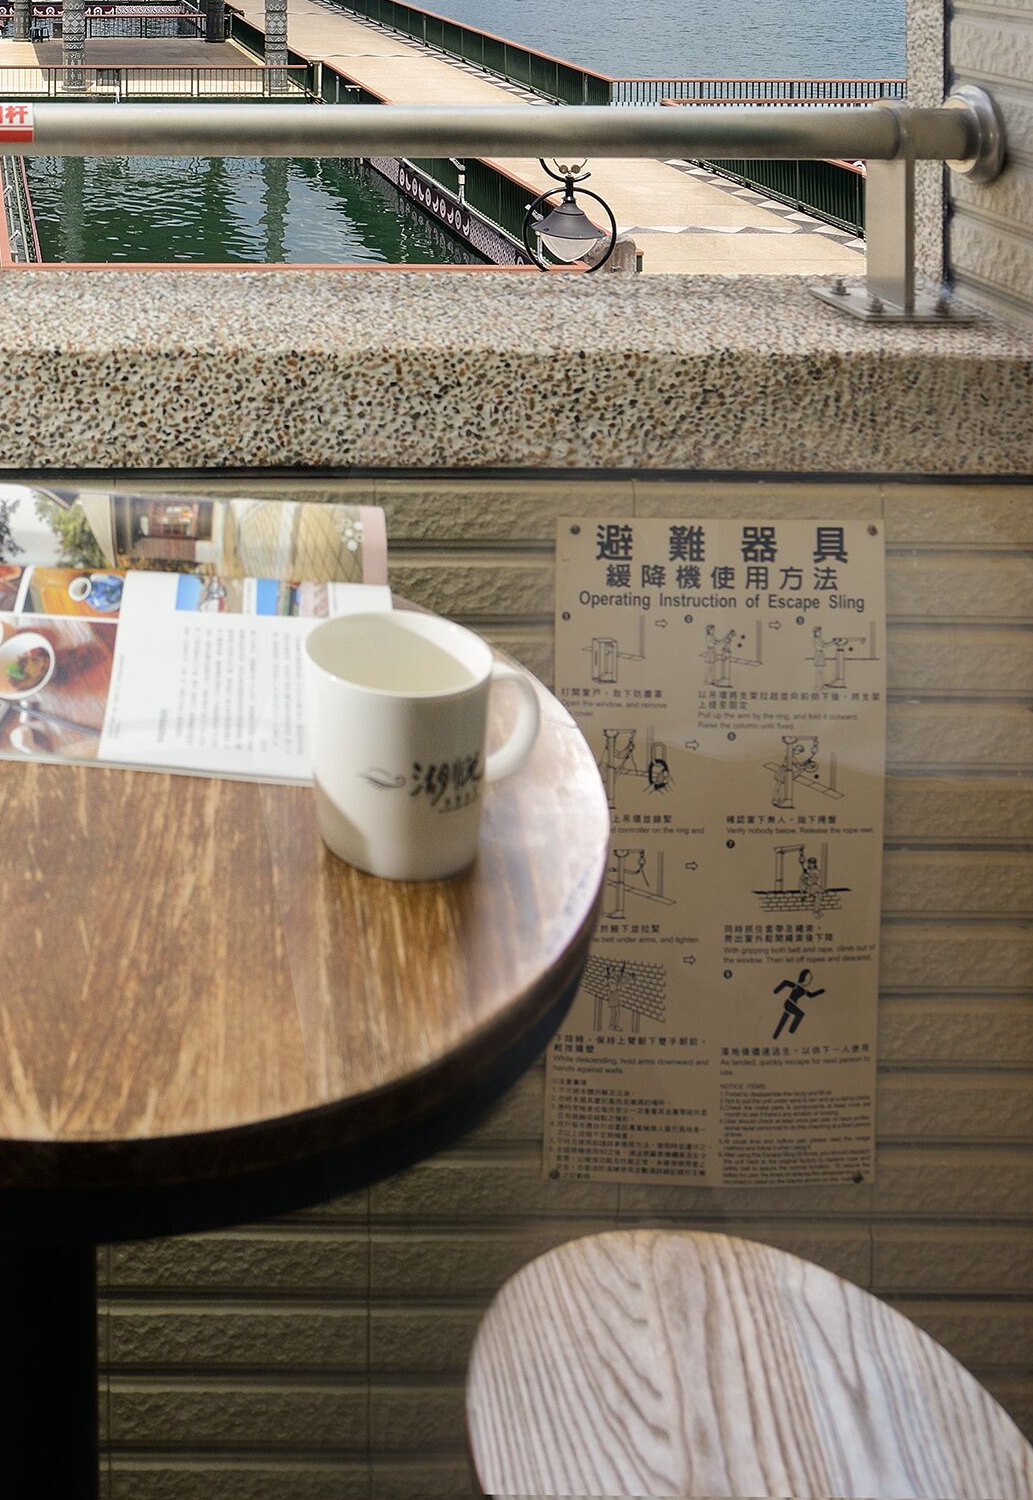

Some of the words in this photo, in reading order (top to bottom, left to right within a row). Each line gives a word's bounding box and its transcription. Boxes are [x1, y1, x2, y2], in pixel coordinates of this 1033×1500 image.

[596, 524, 849, 564] 避難器具
[606, 564, 839, 591] 緩降機使用方法
[579, 590, 651, 610] Operating
[659, 591, 737, 609] Instruction
[746, 593, 761, 609] of
[768, 595, 821, 612] Escape
[828, 595, 865, 613] Sling
